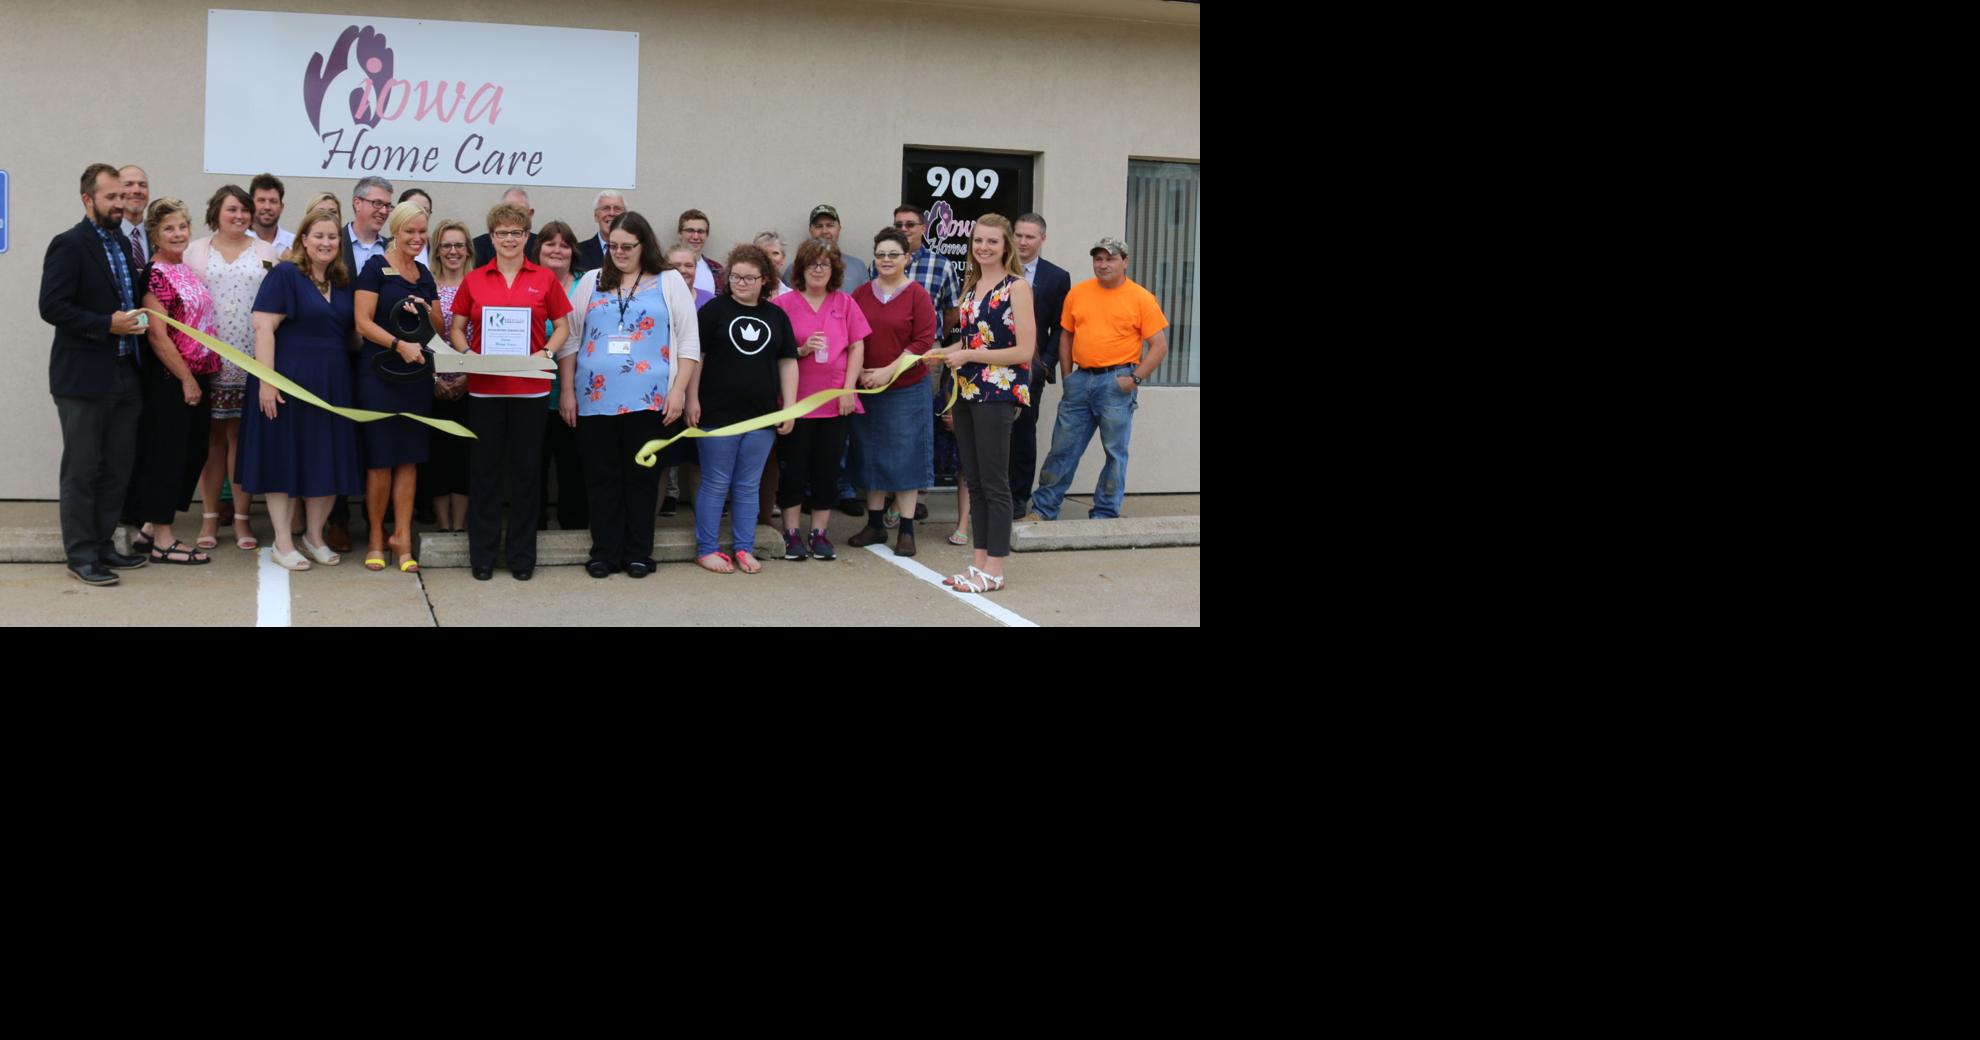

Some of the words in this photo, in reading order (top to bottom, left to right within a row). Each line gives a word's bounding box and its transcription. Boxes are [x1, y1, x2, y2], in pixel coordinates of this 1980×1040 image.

[321, 128, 439, 173] Home
[454, 133, 544, 177] Care
[926, 166, 999, 199] 909
[928, 237, 968, 256] Home
